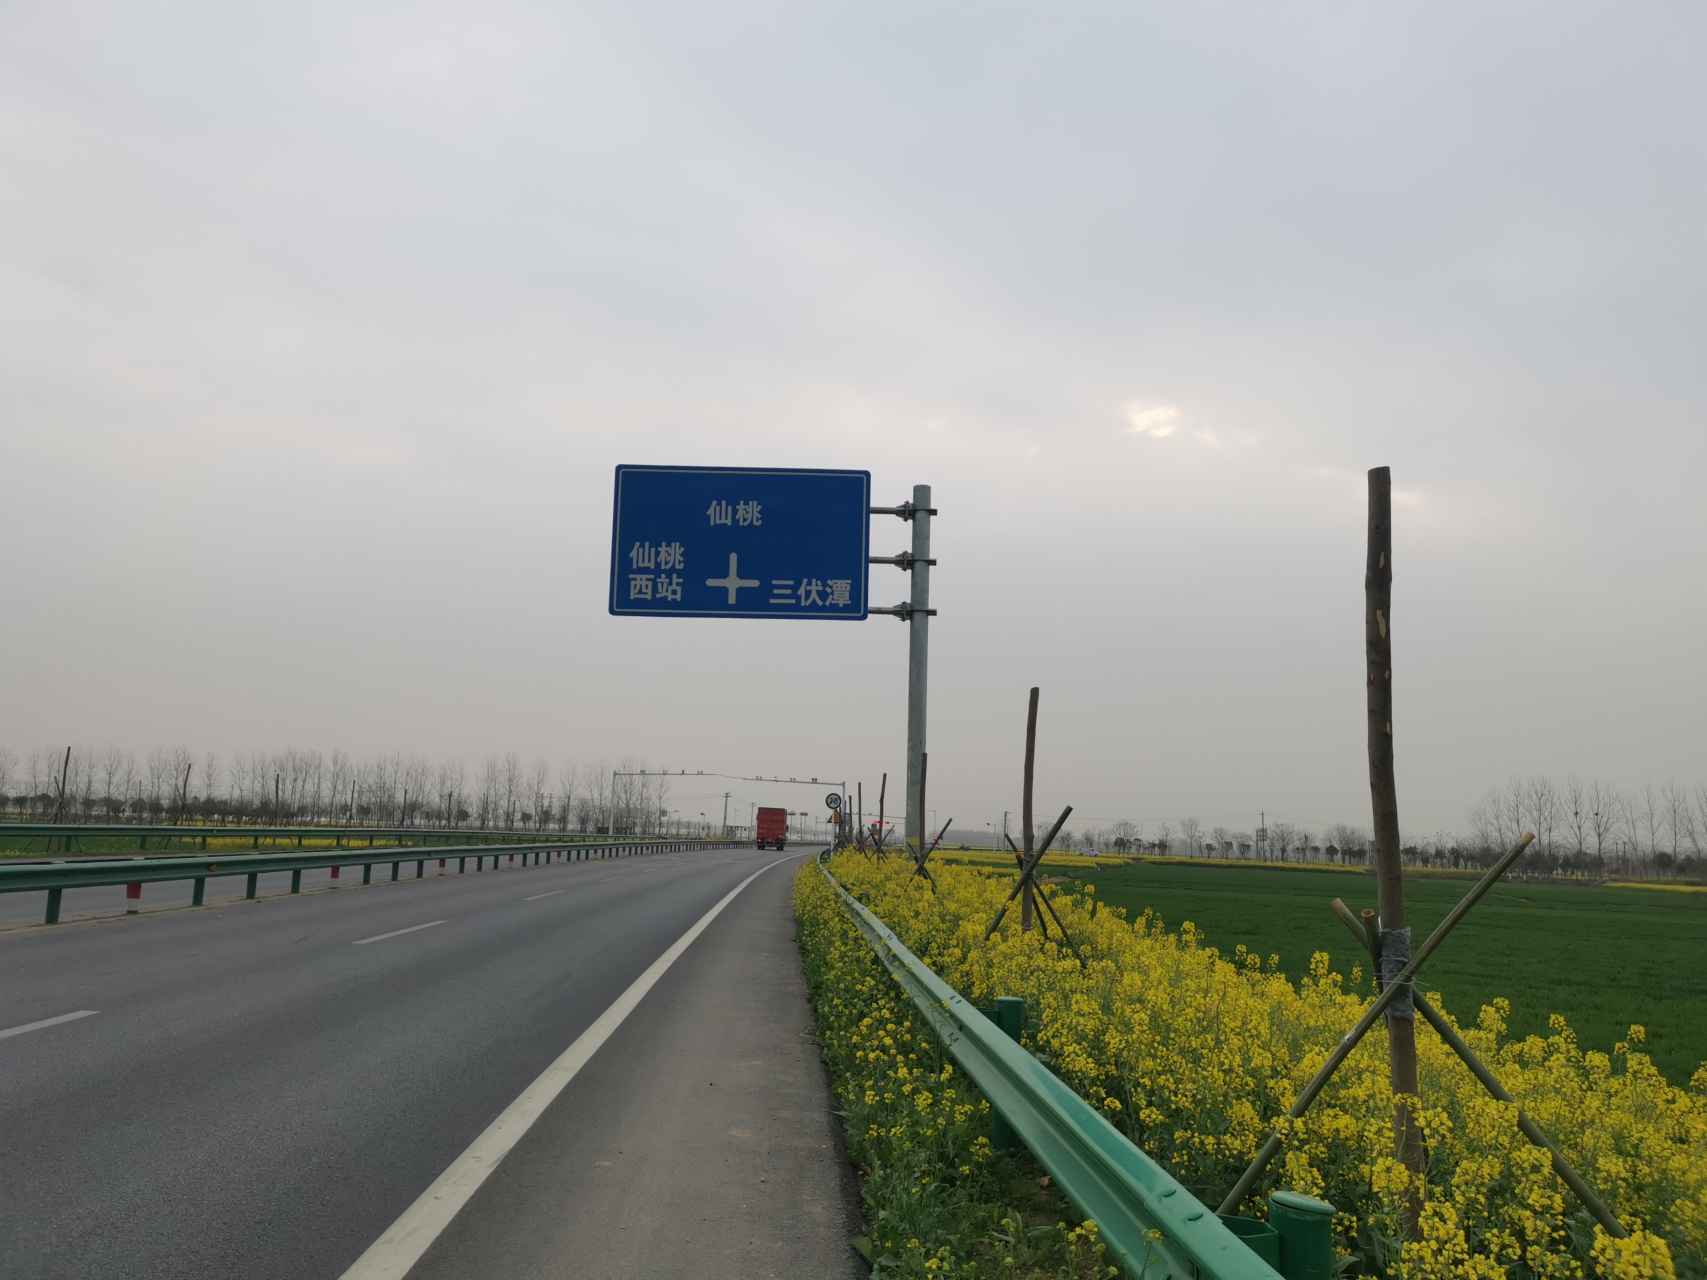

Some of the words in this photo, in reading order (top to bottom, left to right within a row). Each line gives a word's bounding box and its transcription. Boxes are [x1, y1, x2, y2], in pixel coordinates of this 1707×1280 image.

[706, 500, 762, 526] 仙桃
[629, 541, 685, 570] 仙桃
[628, 573, 684, 601] 西站
[769, 578, 852, 608] 三伏潭
